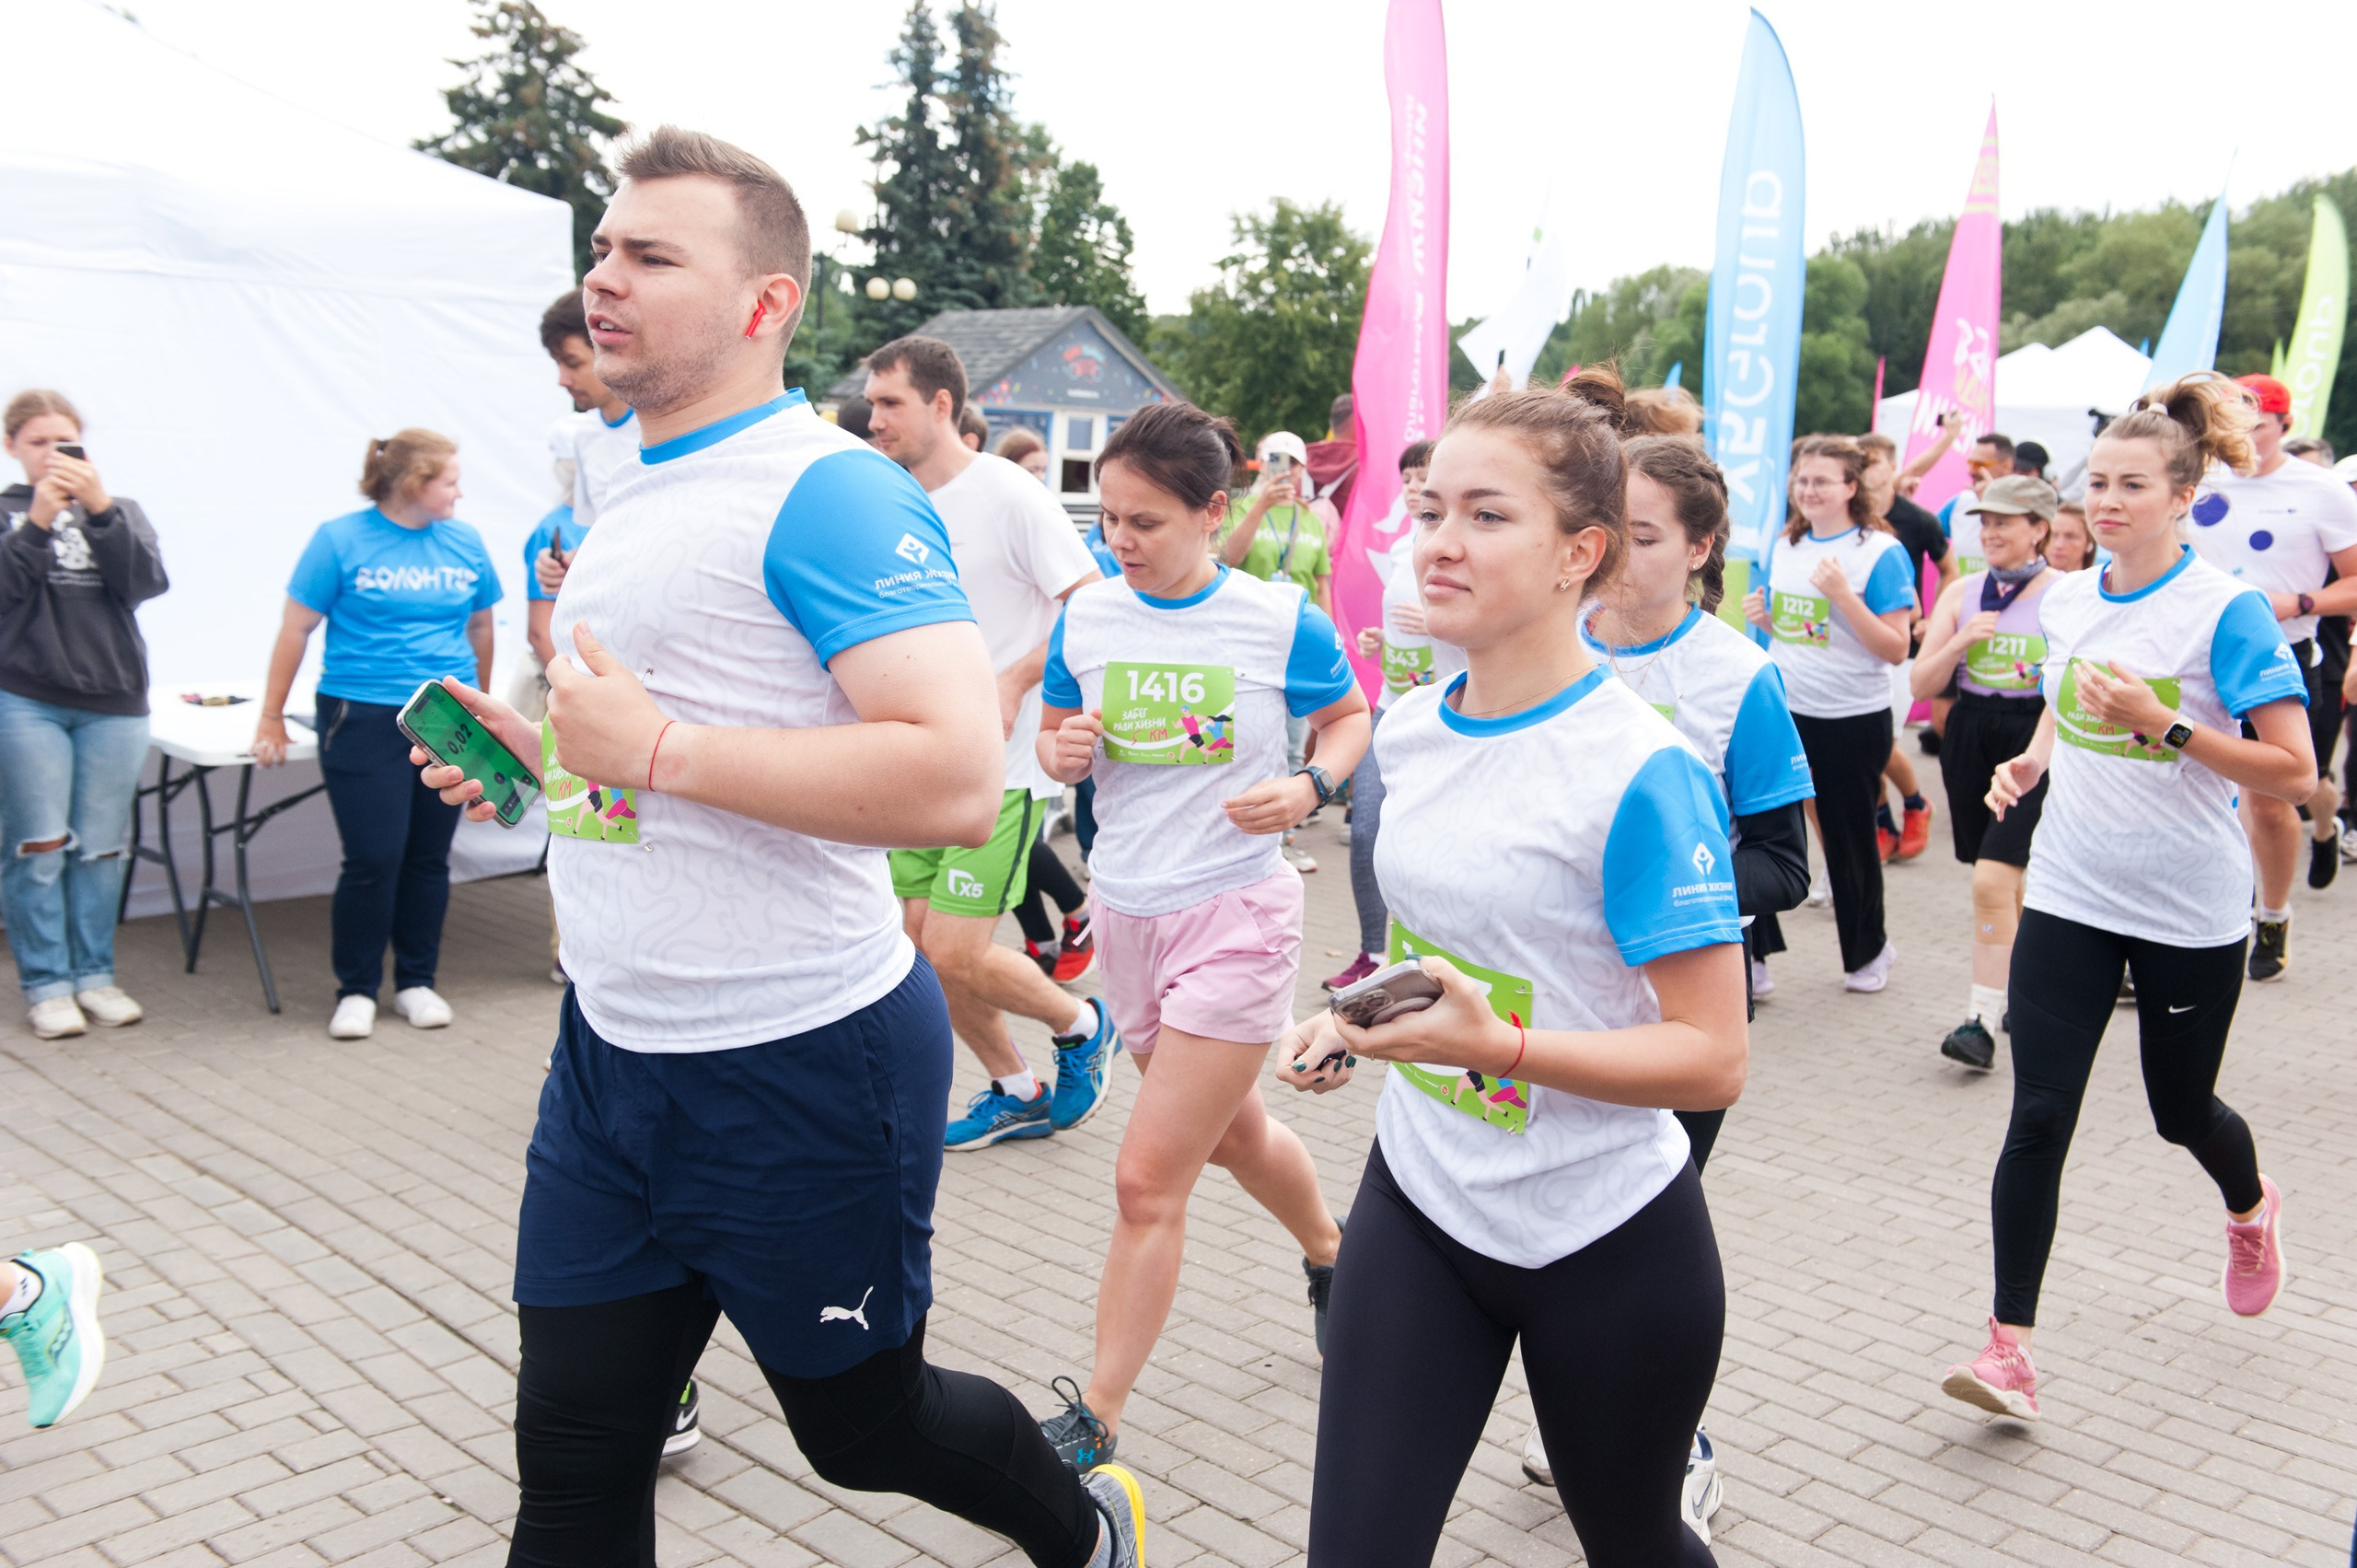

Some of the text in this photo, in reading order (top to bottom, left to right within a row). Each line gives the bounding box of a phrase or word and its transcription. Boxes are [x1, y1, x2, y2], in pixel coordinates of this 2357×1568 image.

[875, 571, 923, 590] ЛИНИЯ
[1782, 595, 1815, 618] 1212
[1987, 635, 2027, 656] 1211
[1126, 669, 1205, 703] 1416
[1121, 707, 1148, 721] ЗАБЕГ
[1113, 721, 1133, 732] РАДИ
[447, 723, 473, 755] 0,02
[958, 880, 985, 900] X5
